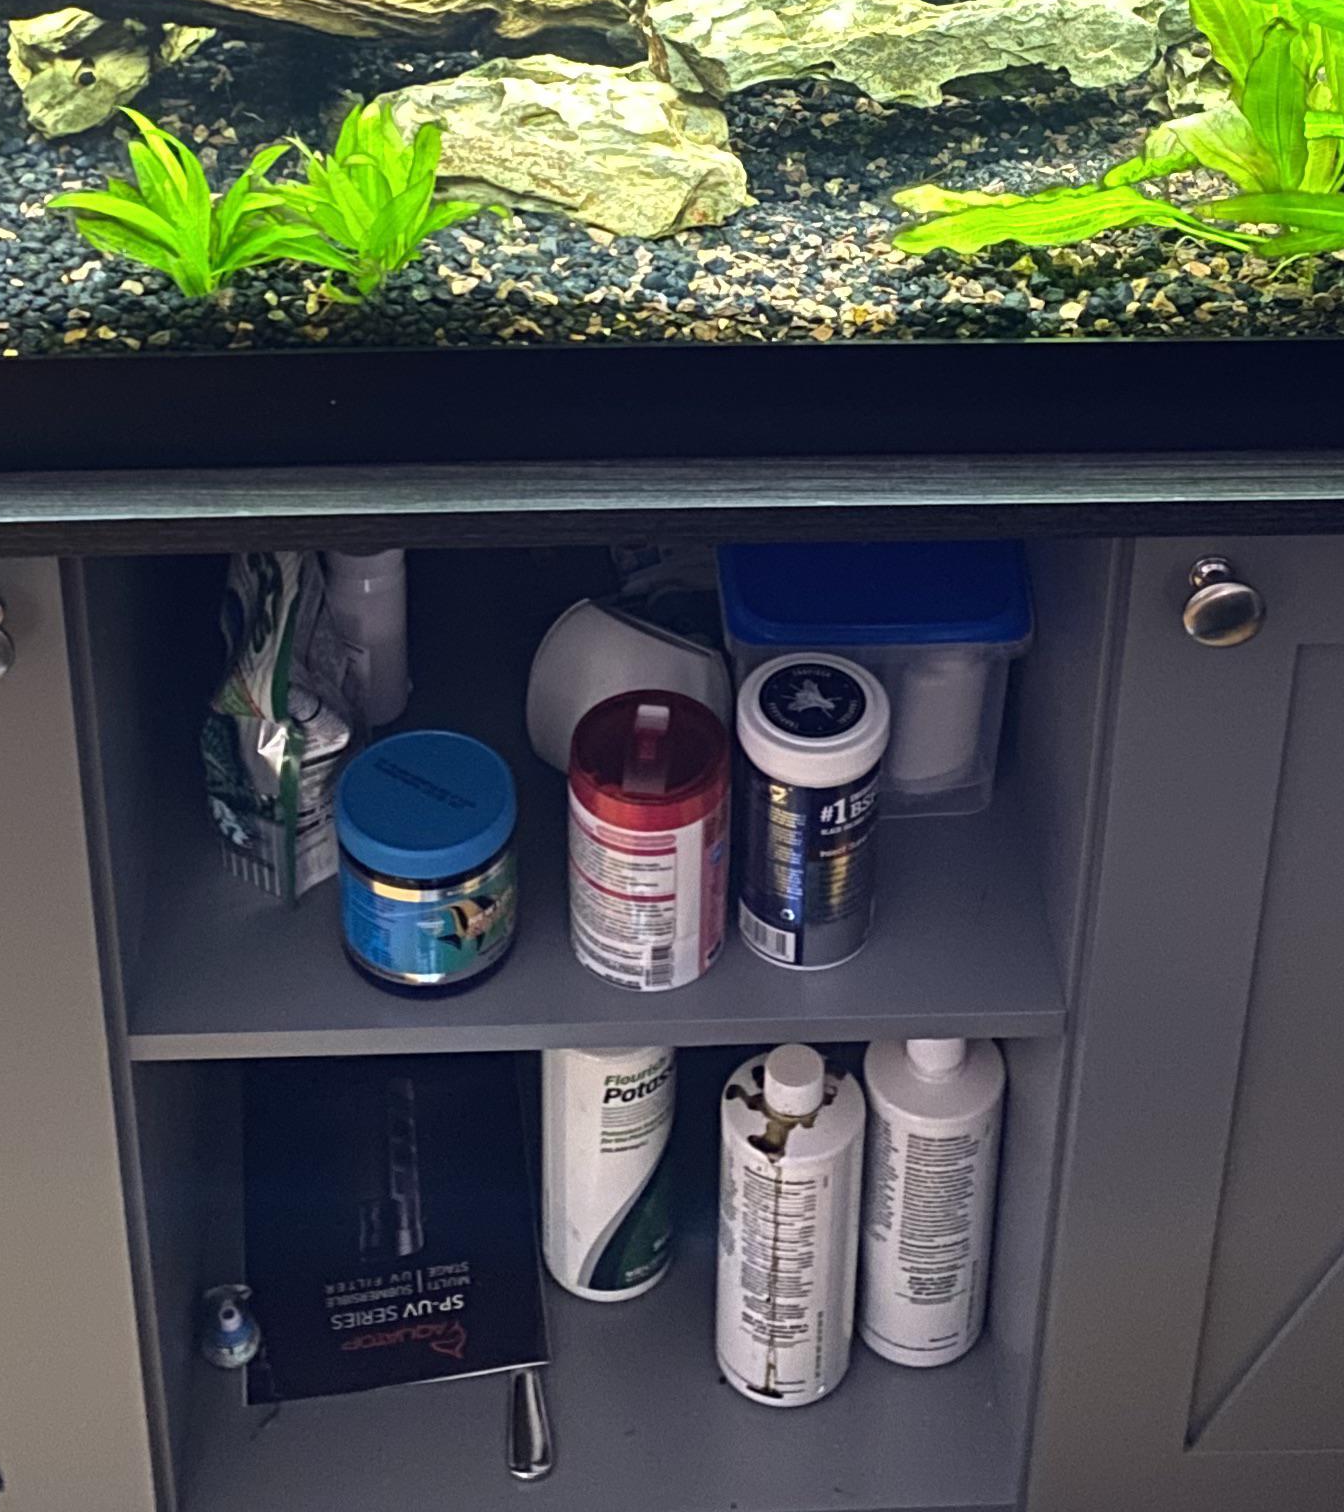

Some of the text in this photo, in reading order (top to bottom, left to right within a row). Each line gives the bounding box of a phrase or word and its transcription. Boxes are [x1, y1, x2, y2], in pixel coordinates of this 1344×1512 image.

[426, 1262, 470, 1278] STAGE
[325, 1277, 383, 1295] FILTER
[426, 1275, 471, 1291] MULTI
[330, 1294, 465, 1330] SP-UV SERIES
